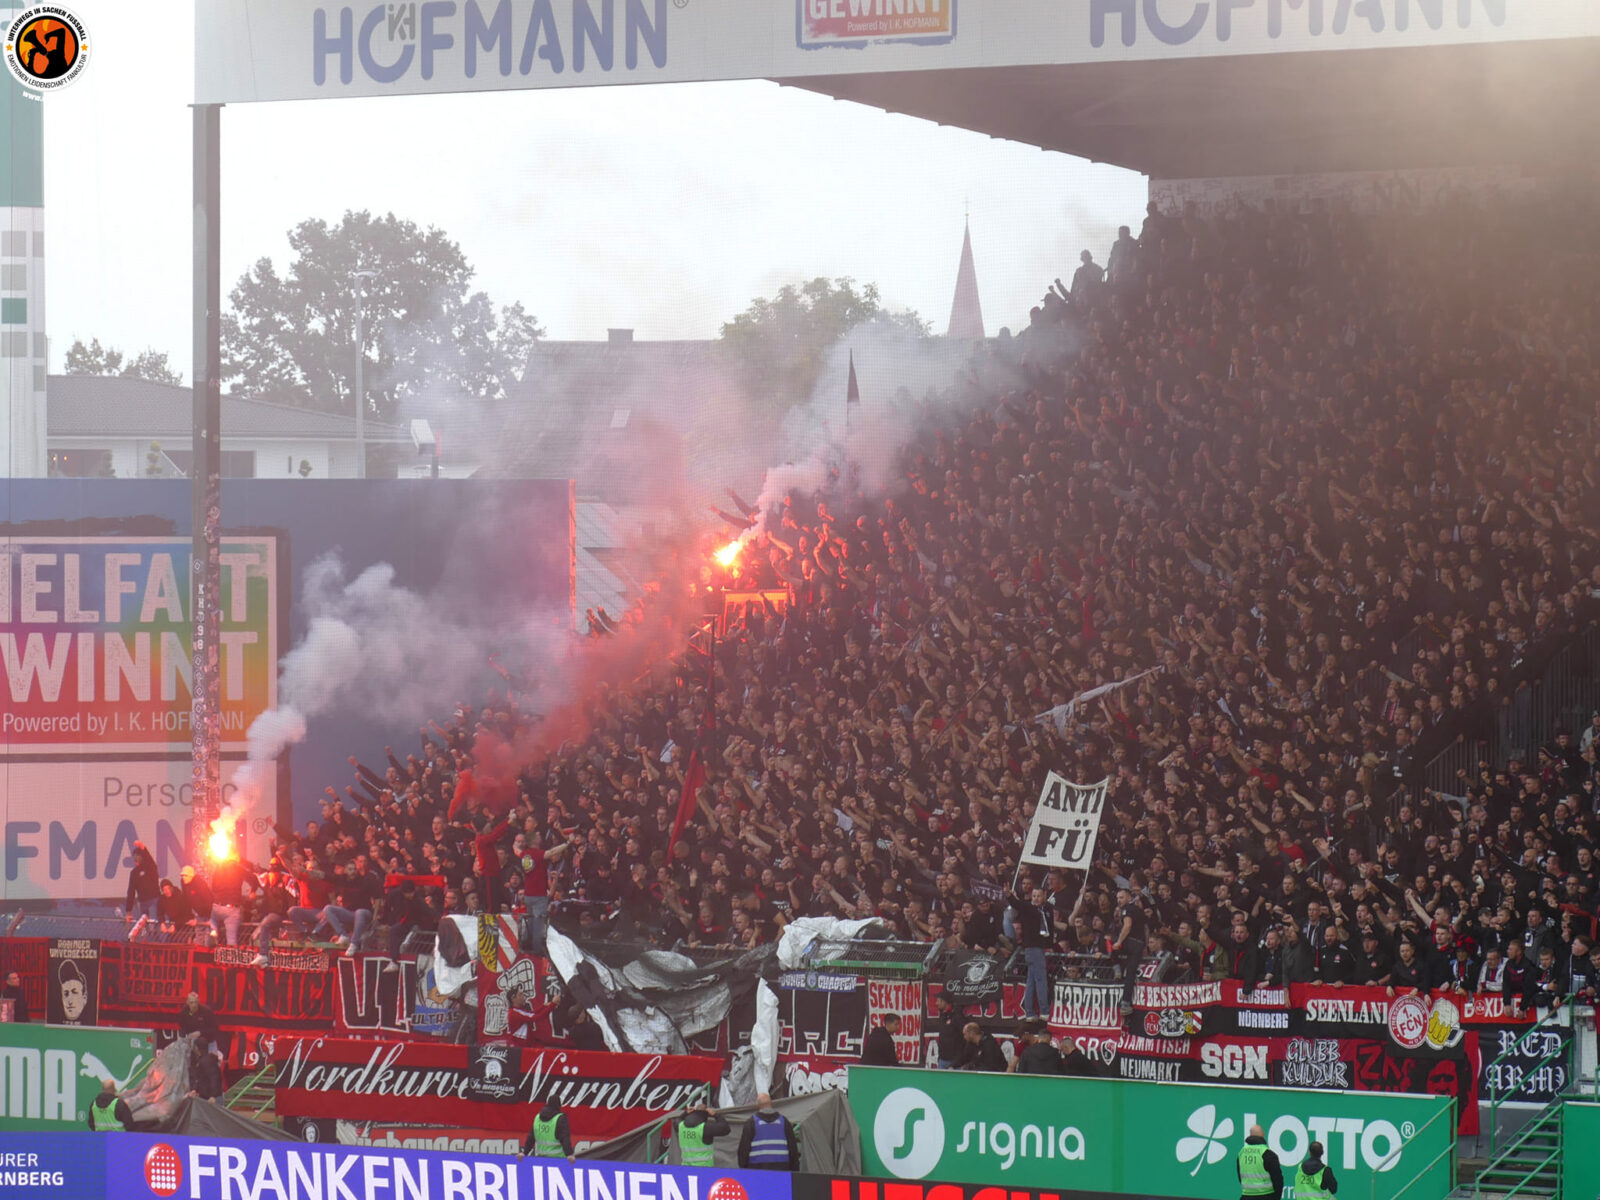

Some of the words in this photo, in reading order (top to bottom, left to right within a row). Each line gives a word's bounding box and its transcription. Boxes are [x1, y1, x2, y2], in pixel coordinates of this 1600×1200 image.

[847, 21, 877, 32] Powered
[879, 20, 888, 32] by
[894, 19, 903, 29] K.
[903, 17, 940, 28] HOFMANN
[313, 0, 668, 86] HOFMANN
[2, 712, 80, 733] Powered
[87, 712, 109, 736] by
[114, 711, 124, 731] I.
[129, 711, 146, 731] K.
[151, 710, 244, 731] HOFNN
[1042, 781, 1106, 814] ANTI
[5, 819, 248, 881] FMAN
[1031, 819, 1093, 863] FÜ
[124, 950, 189, 963] SEKTION
[124, 966, 187, 980] STADION
[121, 982, 184, 996] VERBOT
[869, 982, 921, 1010] SEKTION
[1147, 981, 1222, 1008] BESESSENEN
[870, 1013, 921, 1036] STION
[1238, 1010, 1289, 1029] NÜRNBERG
[1306, 999, 1388, 1025] SEENLAN
[1400, 1014, 1423, 1036] FCN
[1117, 1032, 1191, 1055] STAMMTISCH
[1497, 1030, 1563, 1058] RED
[275, 1038, 468, 1100] Nordkurve
[1120, 1057, 1182, 1082] NEUMARKT
[1201, 1042, 1269, 1080] SGN
[538, 1123, 550, 1134] 190
[682, 1130, 697, 1140] 188
[956, 1121, 1086, 1171] signia
[0, 1152, 39, 1168] RER
[188, 1144, 429, 1200] FRANKEN
[1244, 1156, 1257, 1165] 191
[1300, 1176, 1315, 1185] 230
